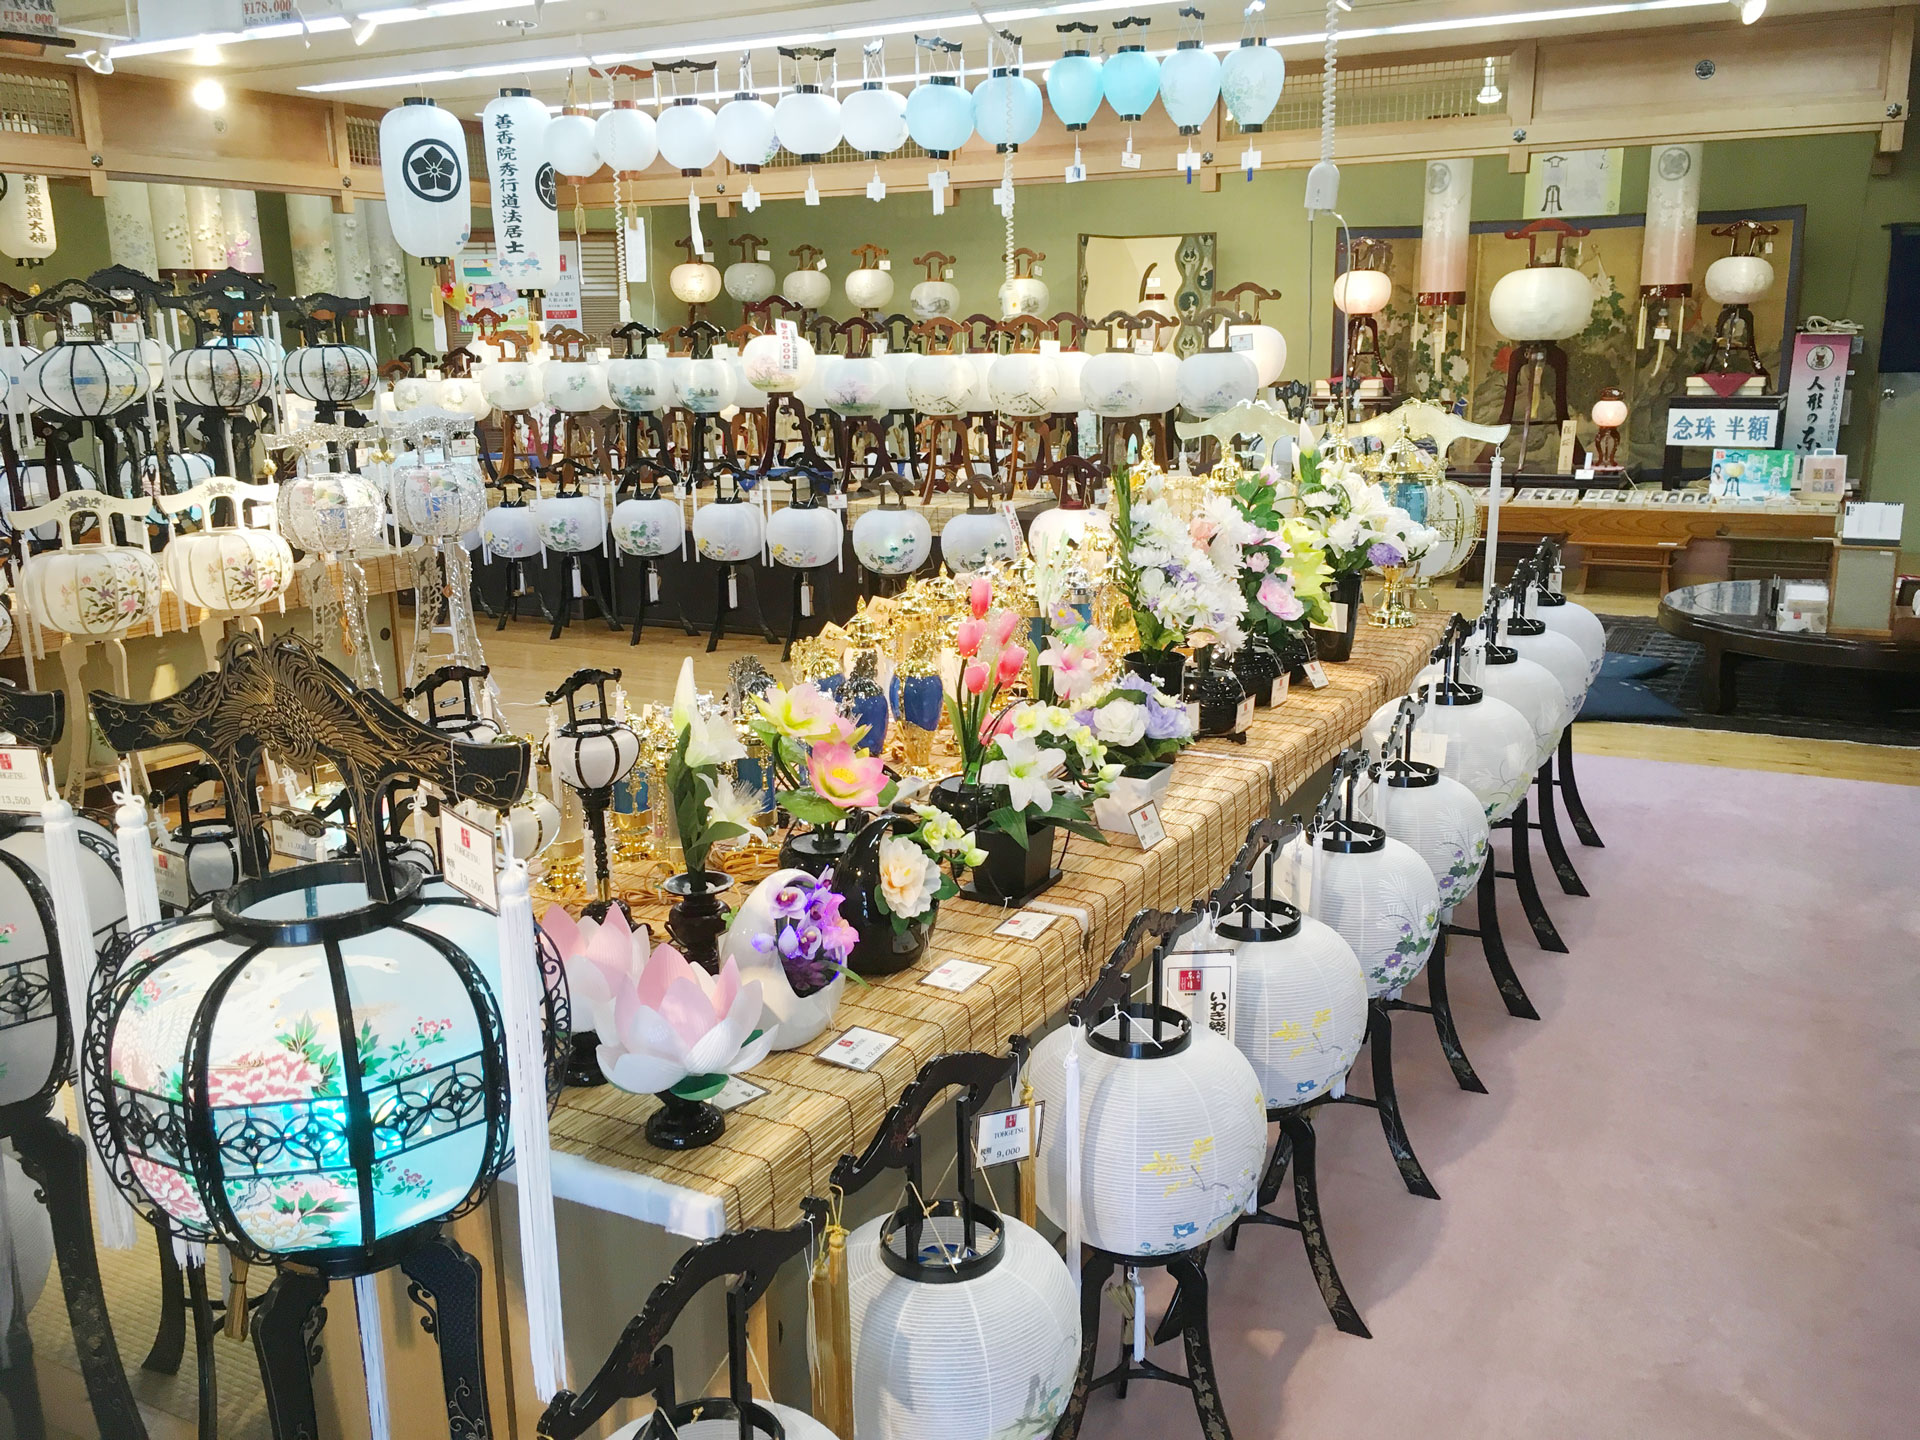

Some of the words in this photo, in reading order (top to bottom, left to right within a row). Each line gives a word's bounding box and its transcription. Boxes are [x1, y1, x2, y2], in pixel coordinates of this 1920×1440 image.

[495, 114, 525, 254] 善香院秀行道法居士
[1672, 415, 1716, 441] 念珠
[1725, 415, 1770, 441] 半額
[1797, 375, 1825, 456] 人形の東
[1209, 992, 1226, 1036] いわき総
[994, 1127, 1026, 1139] TOHGETSU
[996, 1146, 1021, 1158] 9,000
